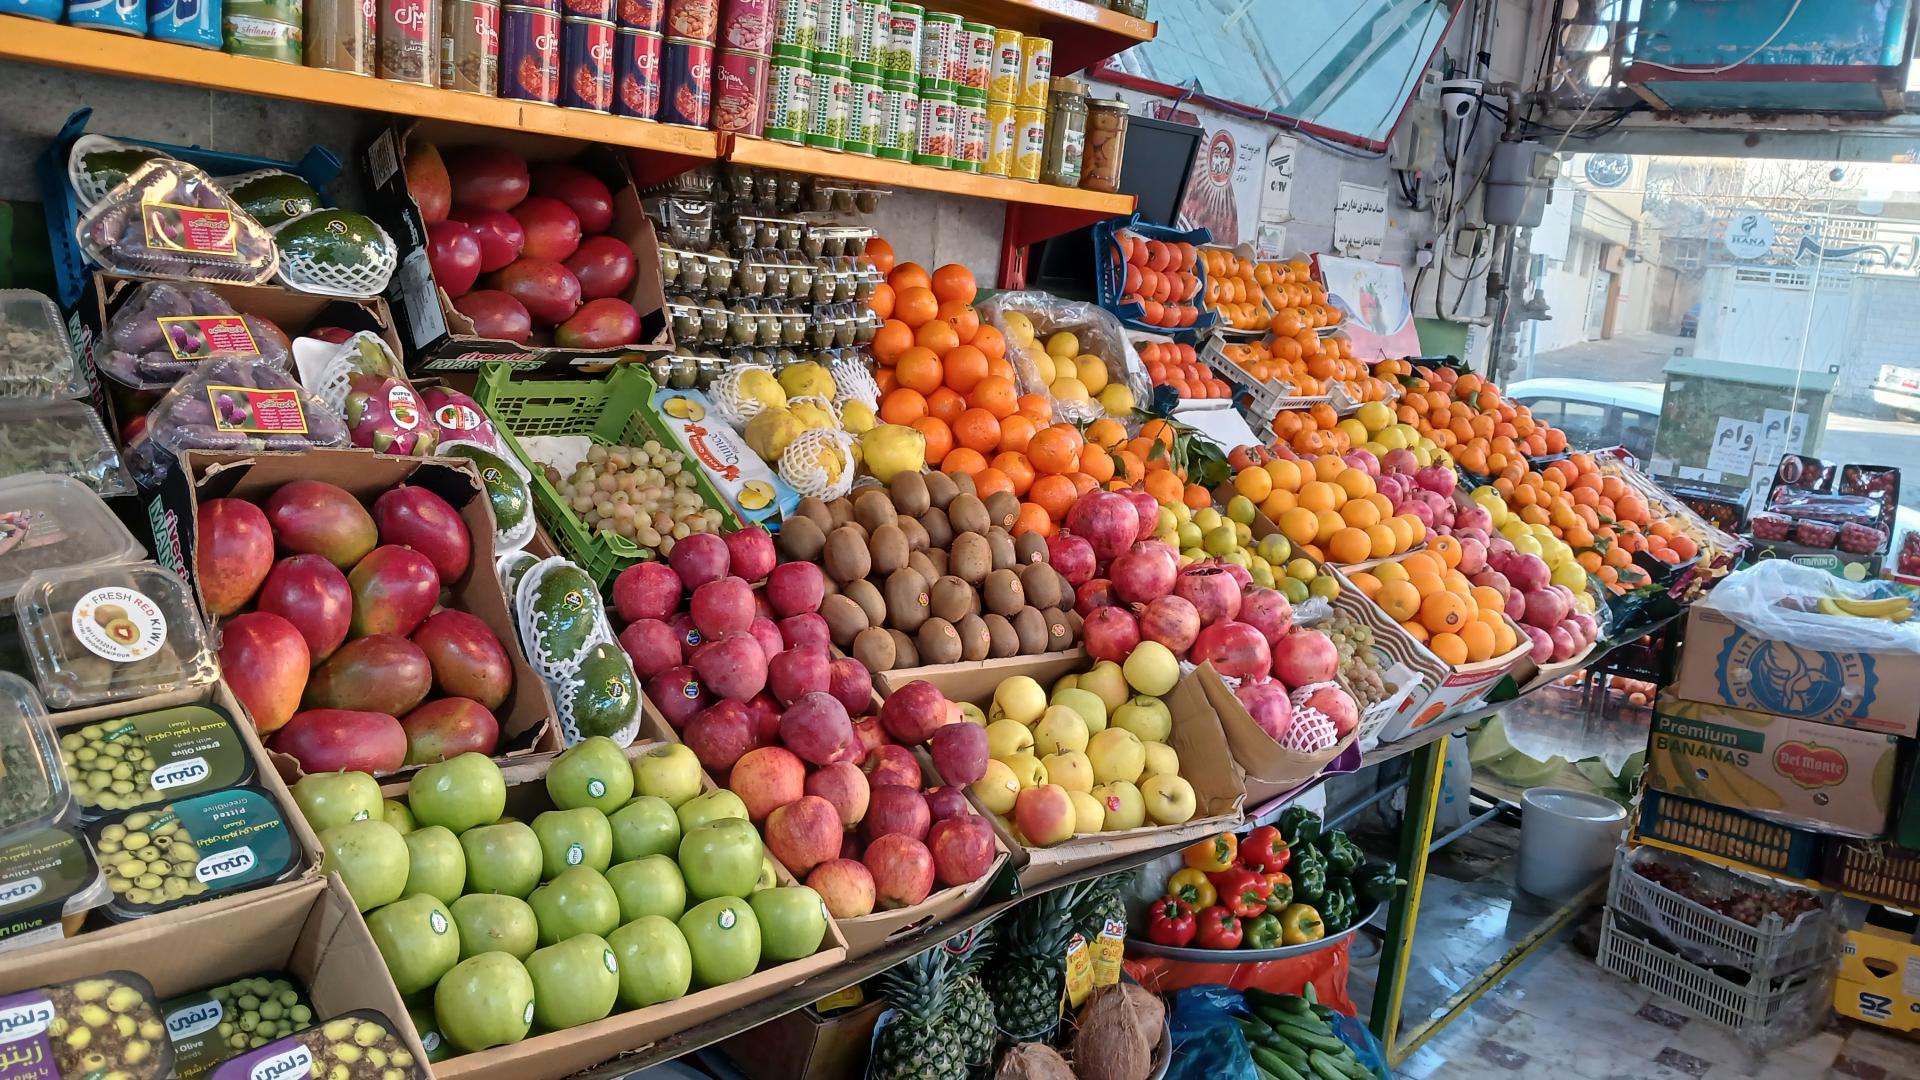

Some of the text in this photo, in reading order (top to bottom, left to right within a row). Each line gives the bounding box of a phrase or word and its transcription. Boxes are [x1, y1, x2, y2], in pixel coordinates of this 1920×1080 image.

[1270, 180, 1287, 193] CTV
[1732, 235, 1766, 247] HANA
[424, 358, 547, 372] MANES
[1719, 424, 1754, 451] وام
[1764, 416, 1801, 443] وام
[708, 432, 739, 465] Quince
[164, 508, 190, 586] riversi
[91, 592, 162, 647] FRESH RED KIWI
[144, 732, 170, 744] زیتون
[172, 727, 191, 739] شور
[201, 720, 227, 733] هسته
[1658, 717, 1738, 746] Premium
[171, 740, 221, 758] green Olive
[1656, 735, 1750, 768] BANANAS
[154, 765, 205, 785] دلفین
[1780, 751, 1844, 775] Del Monte
[212, 807, 246, 821] Pitted
[196, 834, 219, 847] زیتون
[219, 831, 237, 843] شور
[250, 819, 279, 833] هسته
[2, 859, 62, 880] green Olive
[199, 853, 250, 877] دلفین
[12, 919, 43, 933] Olive
[1105, 920, 1123, 934] Dole
[0, 1008, 50, 1034] دلفی
[169, 1007, 219, 1032] دلفین
[0, 1040, 43, 1072] زیتو
[180, 1040, 204, 1052] Olive
[255, 1053, 308, 1080] دلفین
